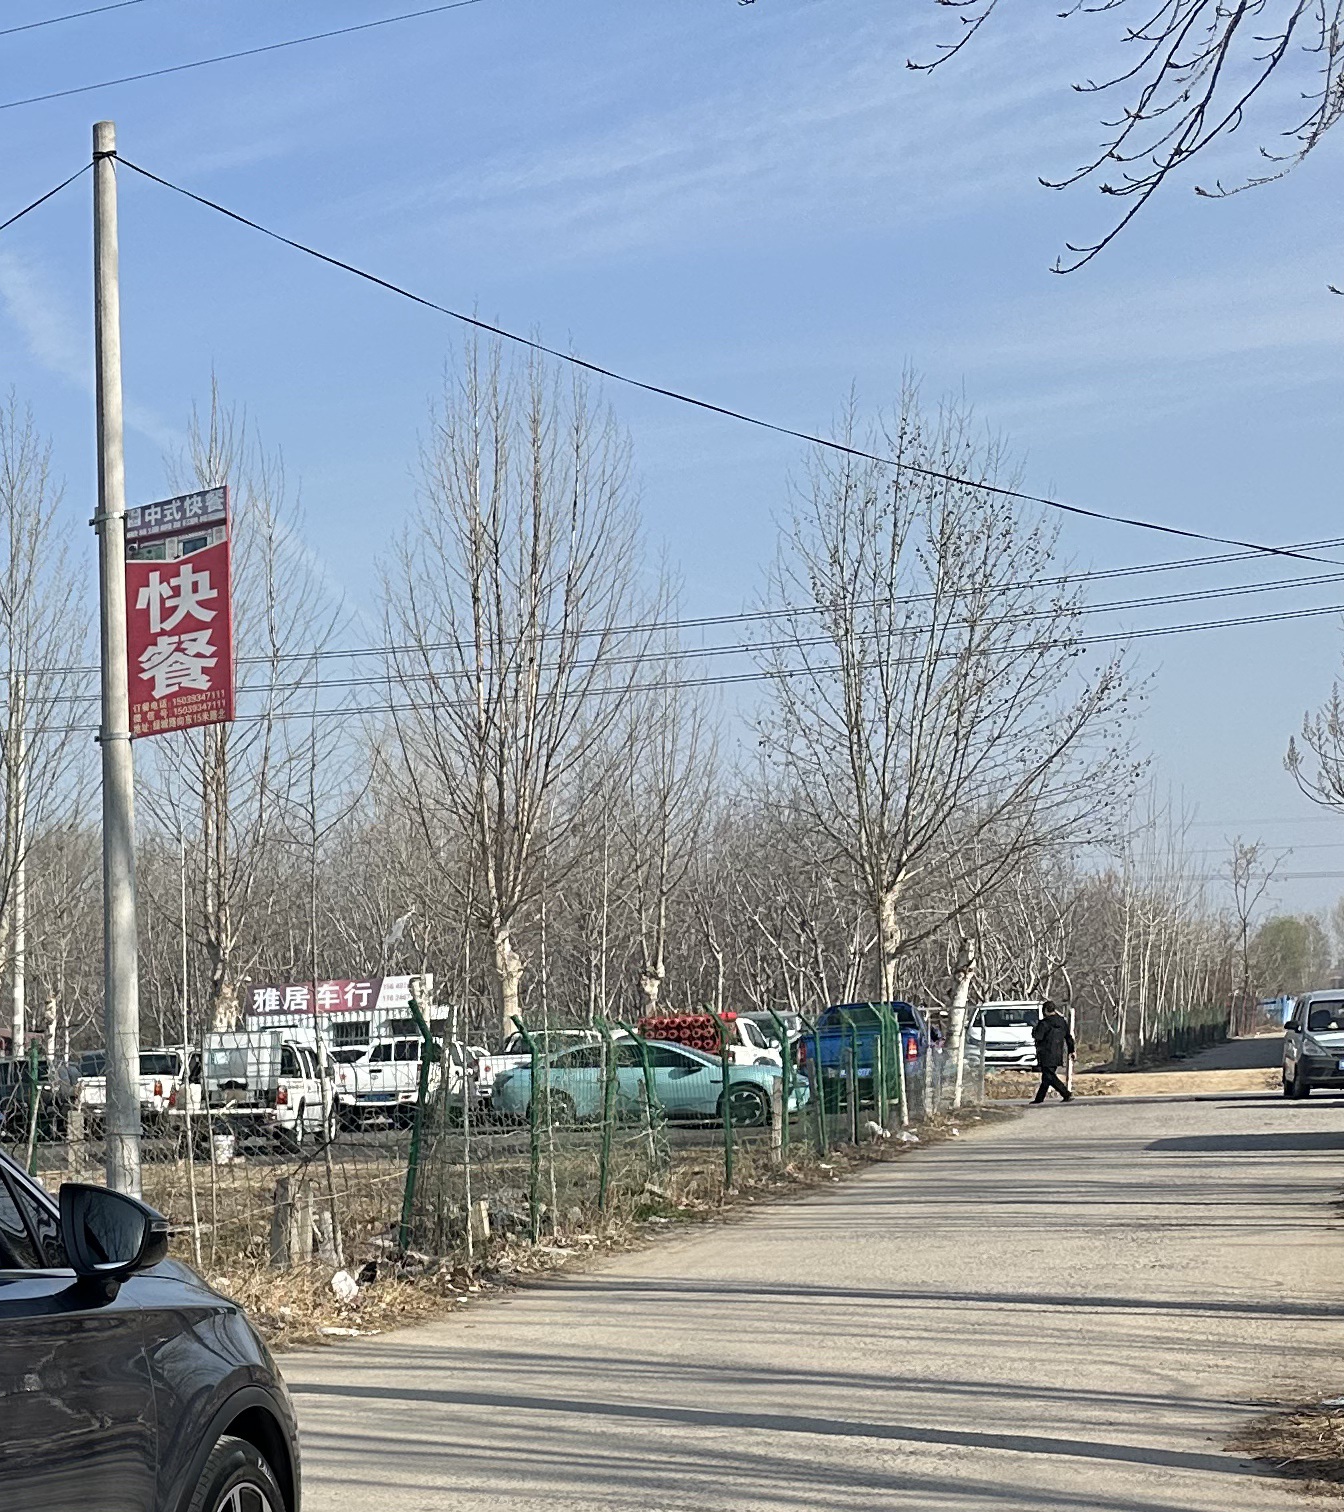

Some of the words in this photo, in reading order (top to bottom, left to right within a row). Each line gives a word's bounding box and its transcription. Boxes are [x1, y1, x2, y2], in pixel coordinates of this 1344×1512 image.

[136, 563, 219, 700] 快餐
[253, 982, 372, 1013] 雅居车行
